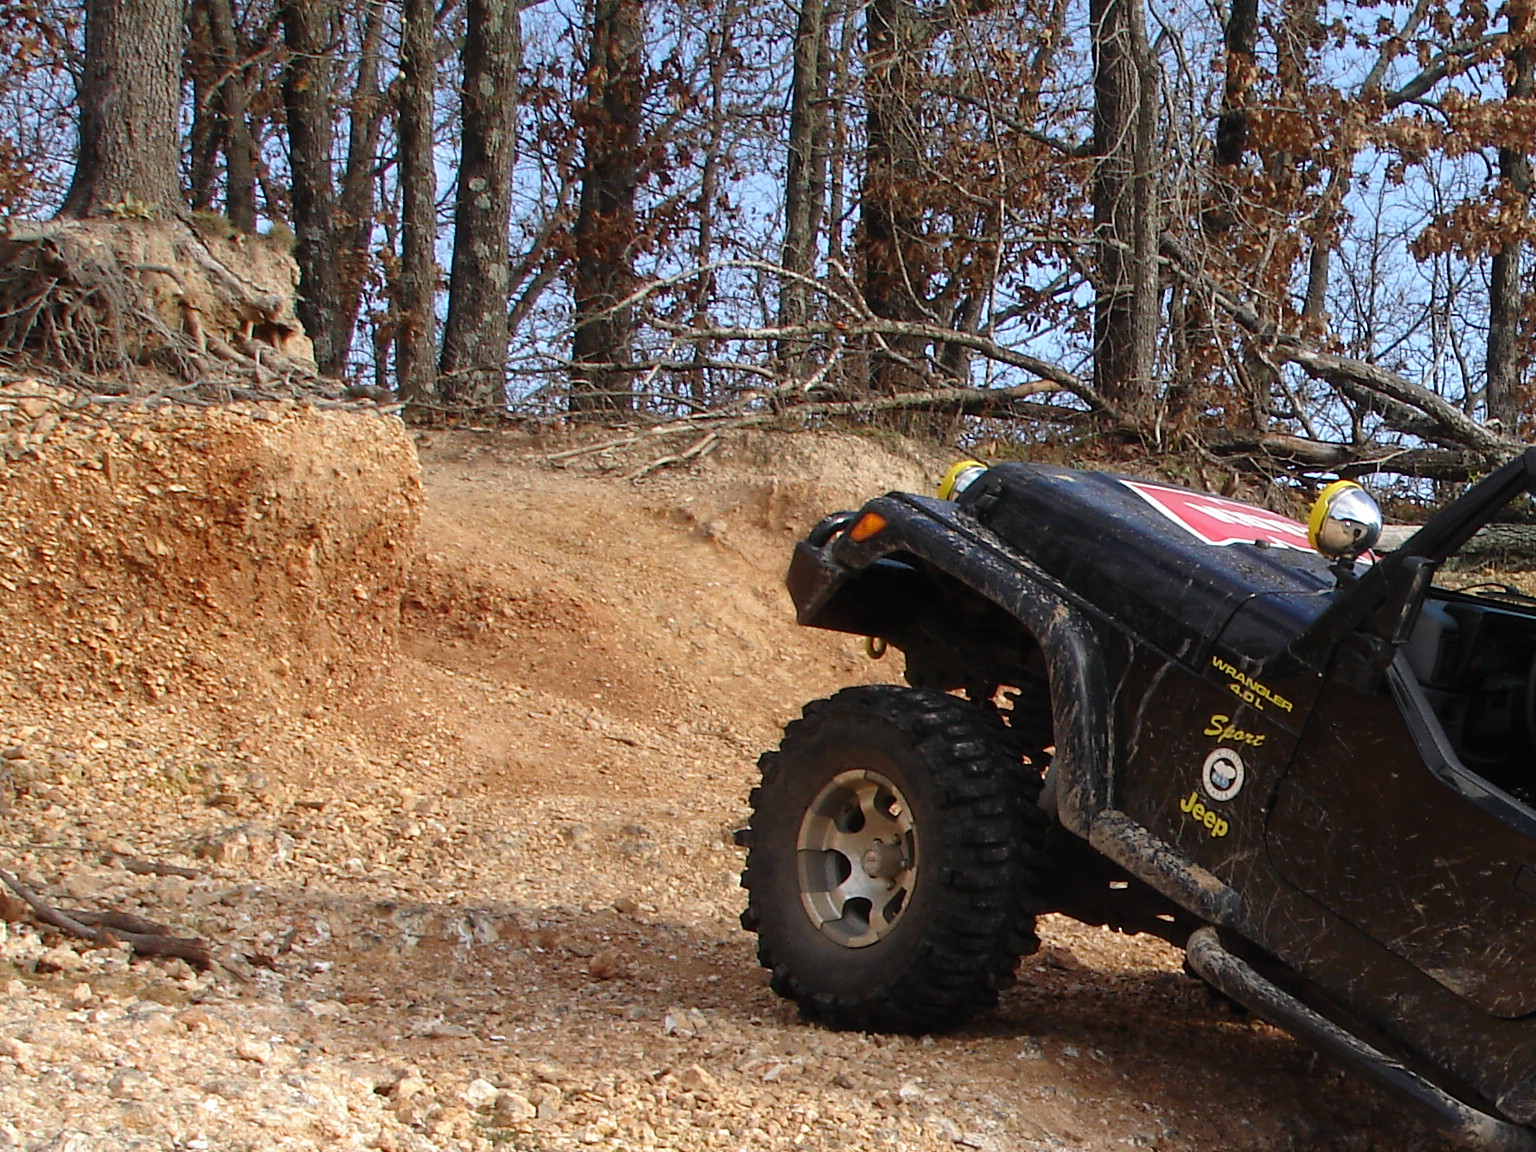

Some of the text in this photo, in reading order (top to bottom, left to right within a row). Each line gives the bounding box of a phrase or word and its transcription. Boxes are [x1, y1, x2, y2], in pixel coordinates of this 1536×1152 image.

[1212, 656, 1294, 713] WRANGLER
[1203, 714, 1266, 747] Sport
[1179, 791, 1229, 837] Jeep
